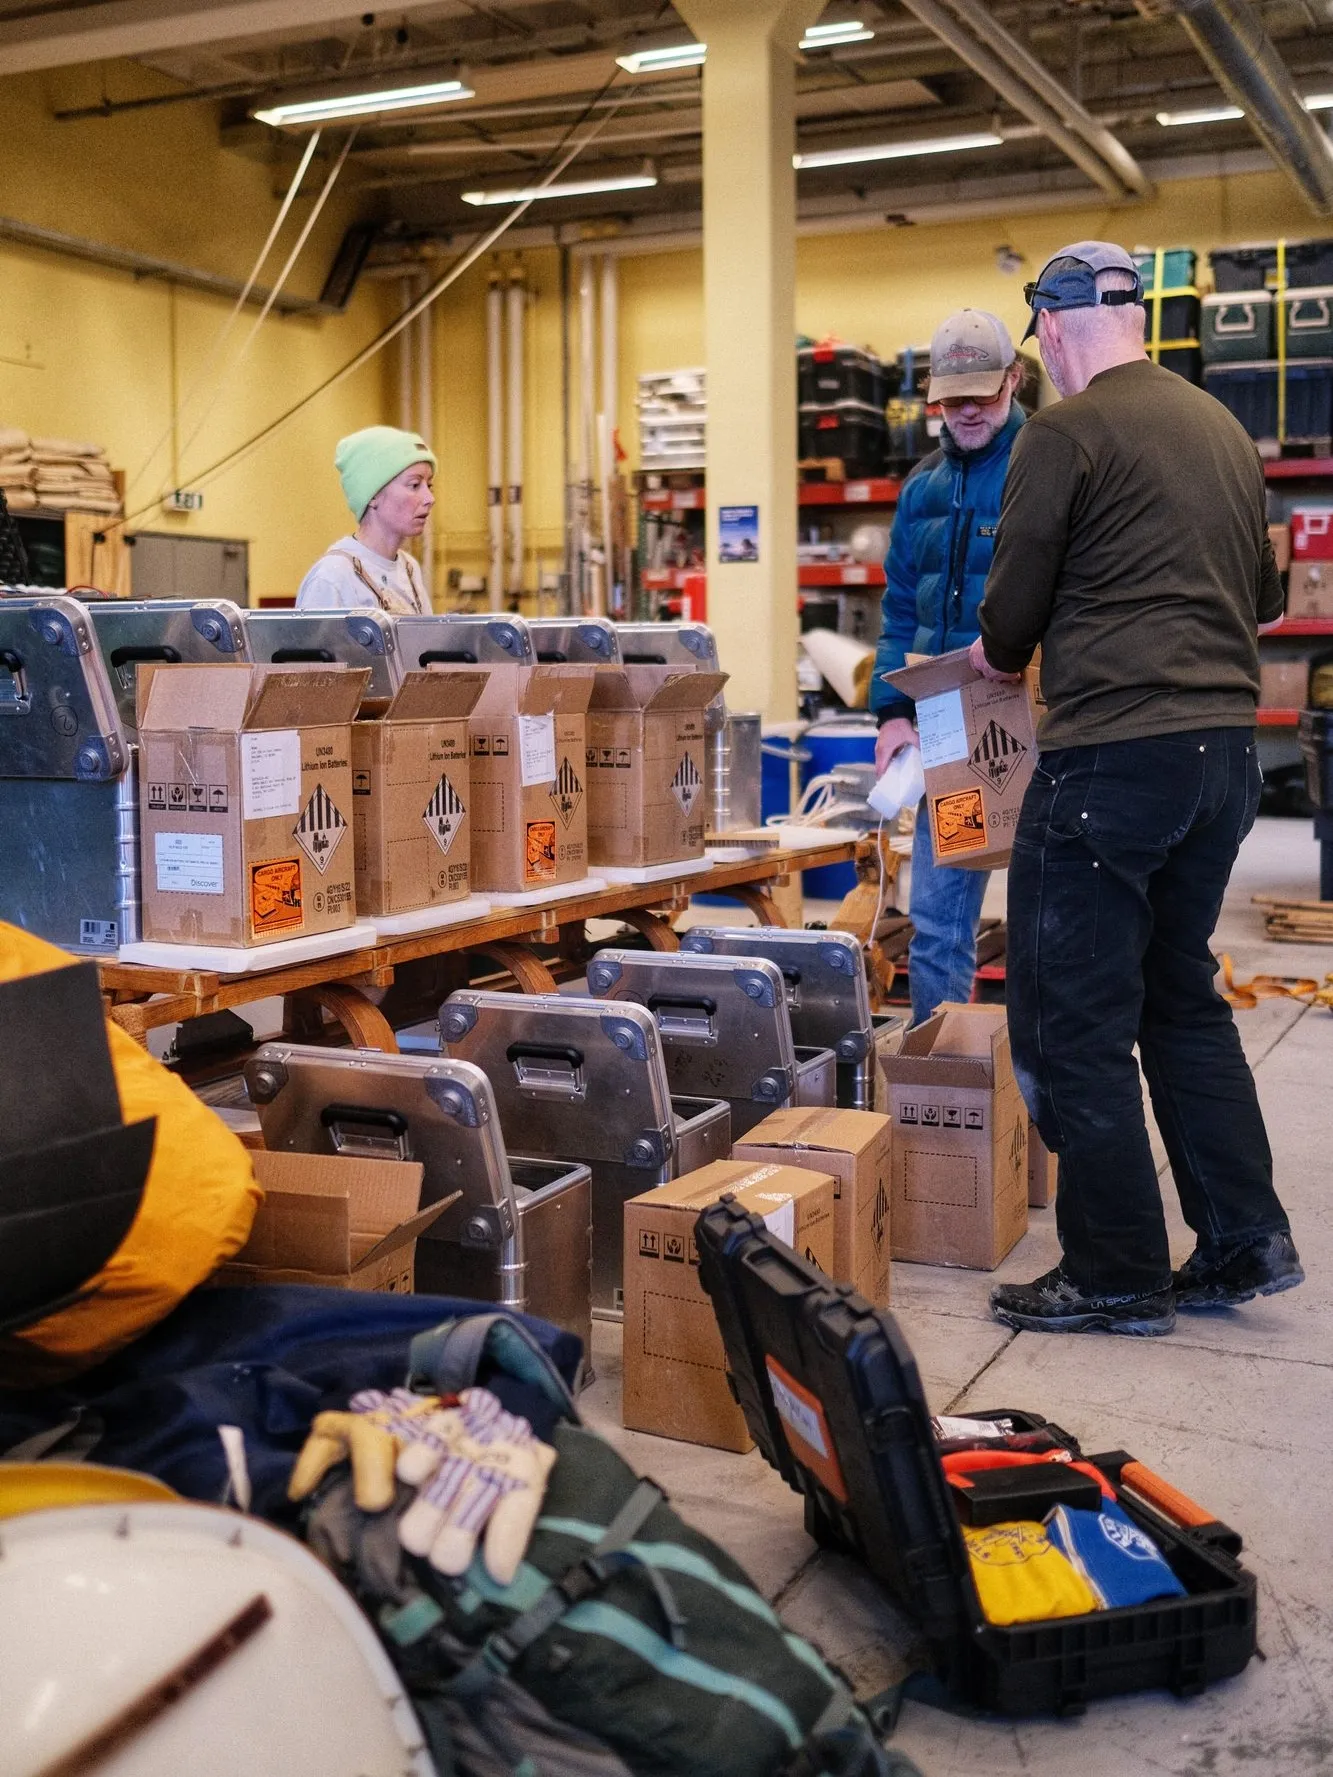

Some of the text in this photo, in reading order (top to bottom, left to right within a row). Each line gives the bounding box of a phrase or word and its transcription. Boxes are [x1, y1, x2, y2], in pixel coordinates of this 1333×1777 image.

[327, 758, 348, 769] Batteries
[319, 856, 325, 864] 9
[257, 864, 296, 877] CARGO AIRCRAFT
[190, 879, 219, 888] Discover
